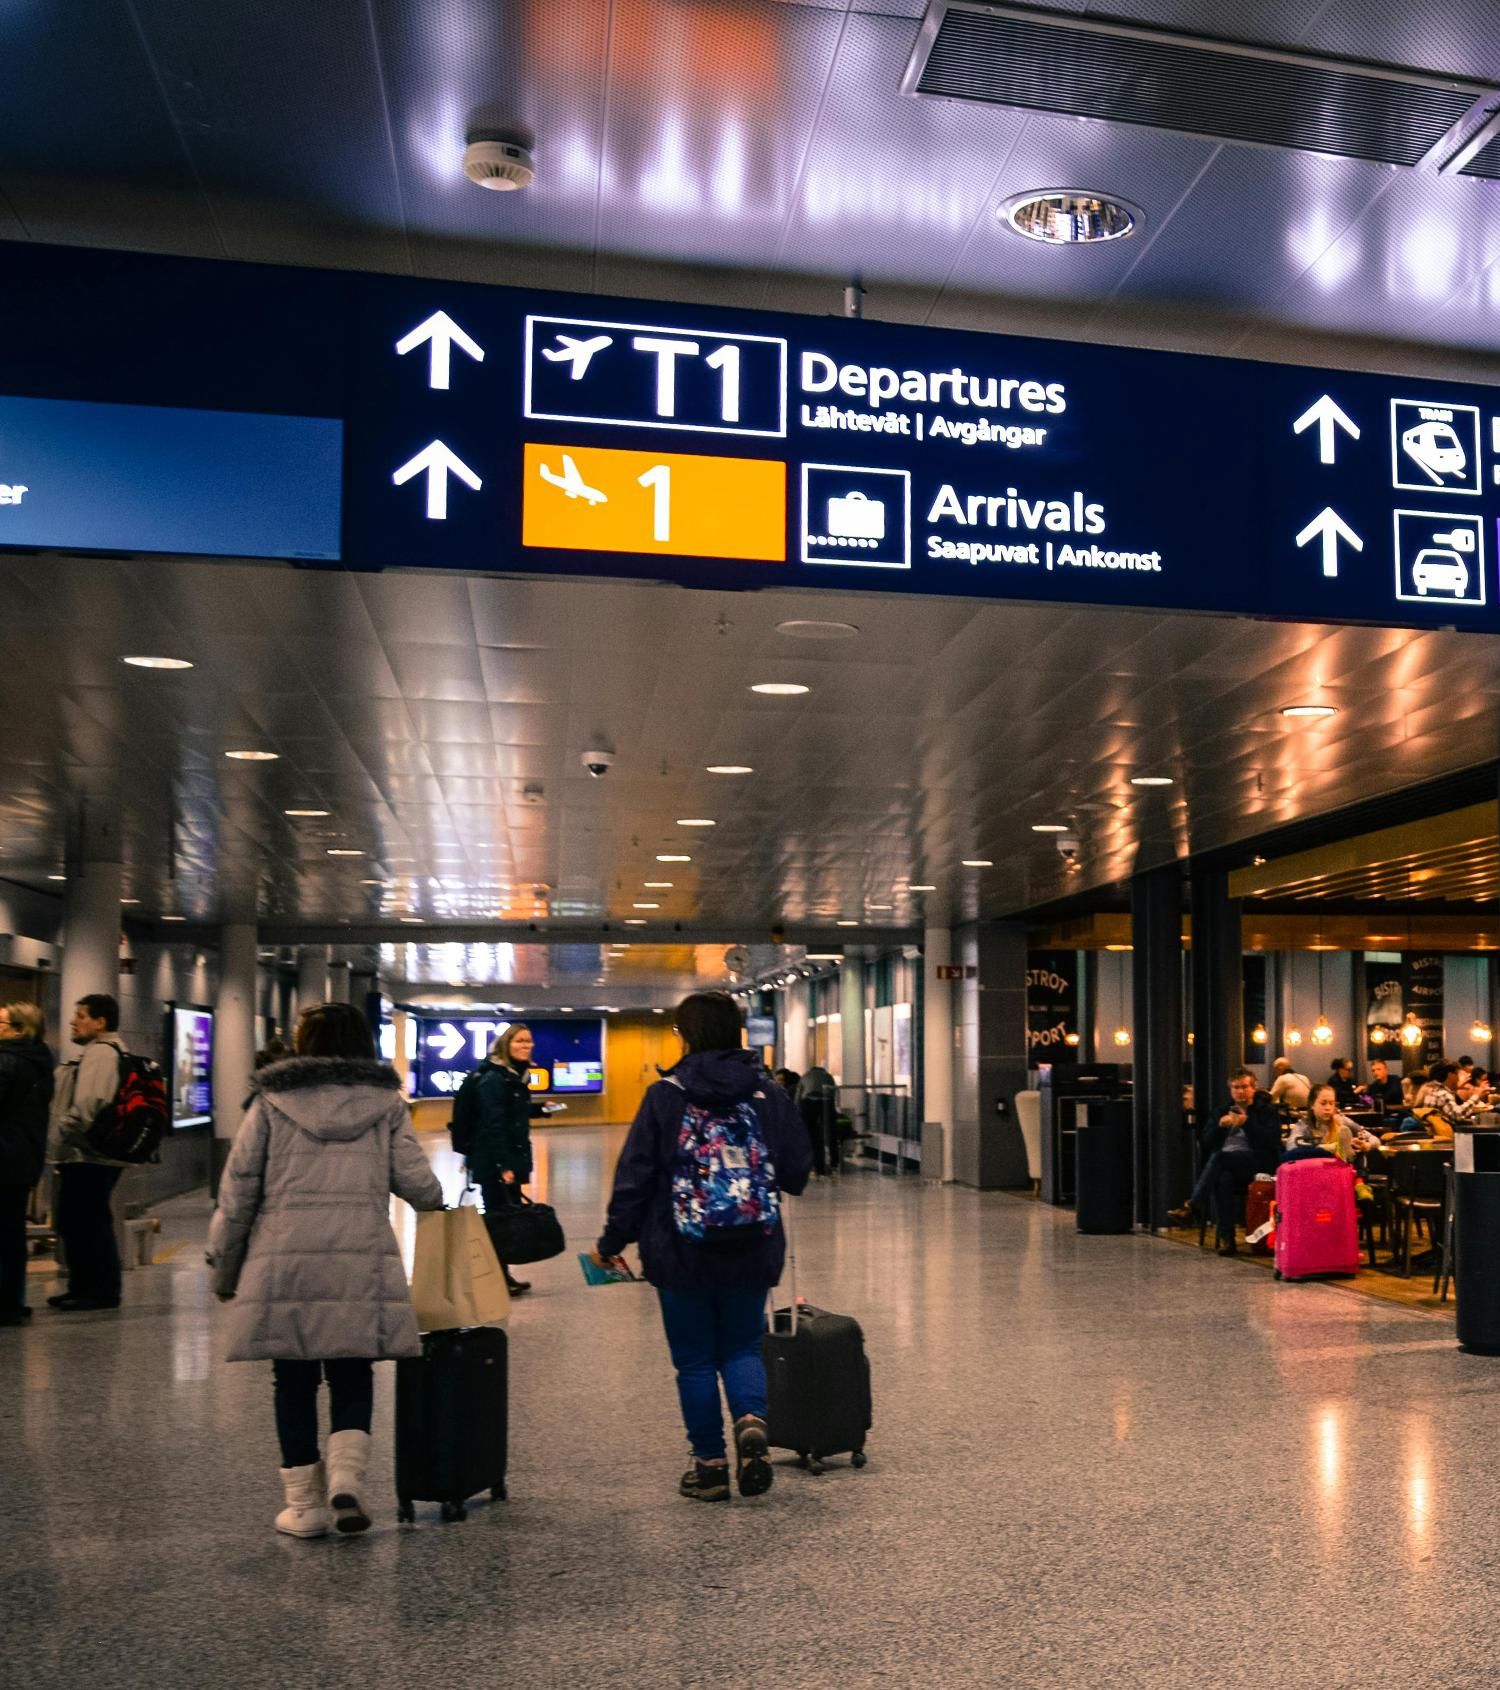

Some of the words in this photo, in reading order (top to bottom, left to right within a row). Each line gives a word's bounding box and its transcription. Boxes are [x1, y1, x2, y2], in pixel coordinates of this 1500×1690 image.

[632, 336, 741, 422] T1
[801, 351, 1066, 414] Departures
[801, 405, 910, 434] Lähtevät
[929, 414, 1046, 448] Avgångar
[638, 465, 670, 541] 1
[927, 484, 1106, 533] Arrivals
[927, 536, 1039, 564] Saapuvat
[1057, 544, 1162, 571] Ankomst
[466, 1021, 511, 1060] T
